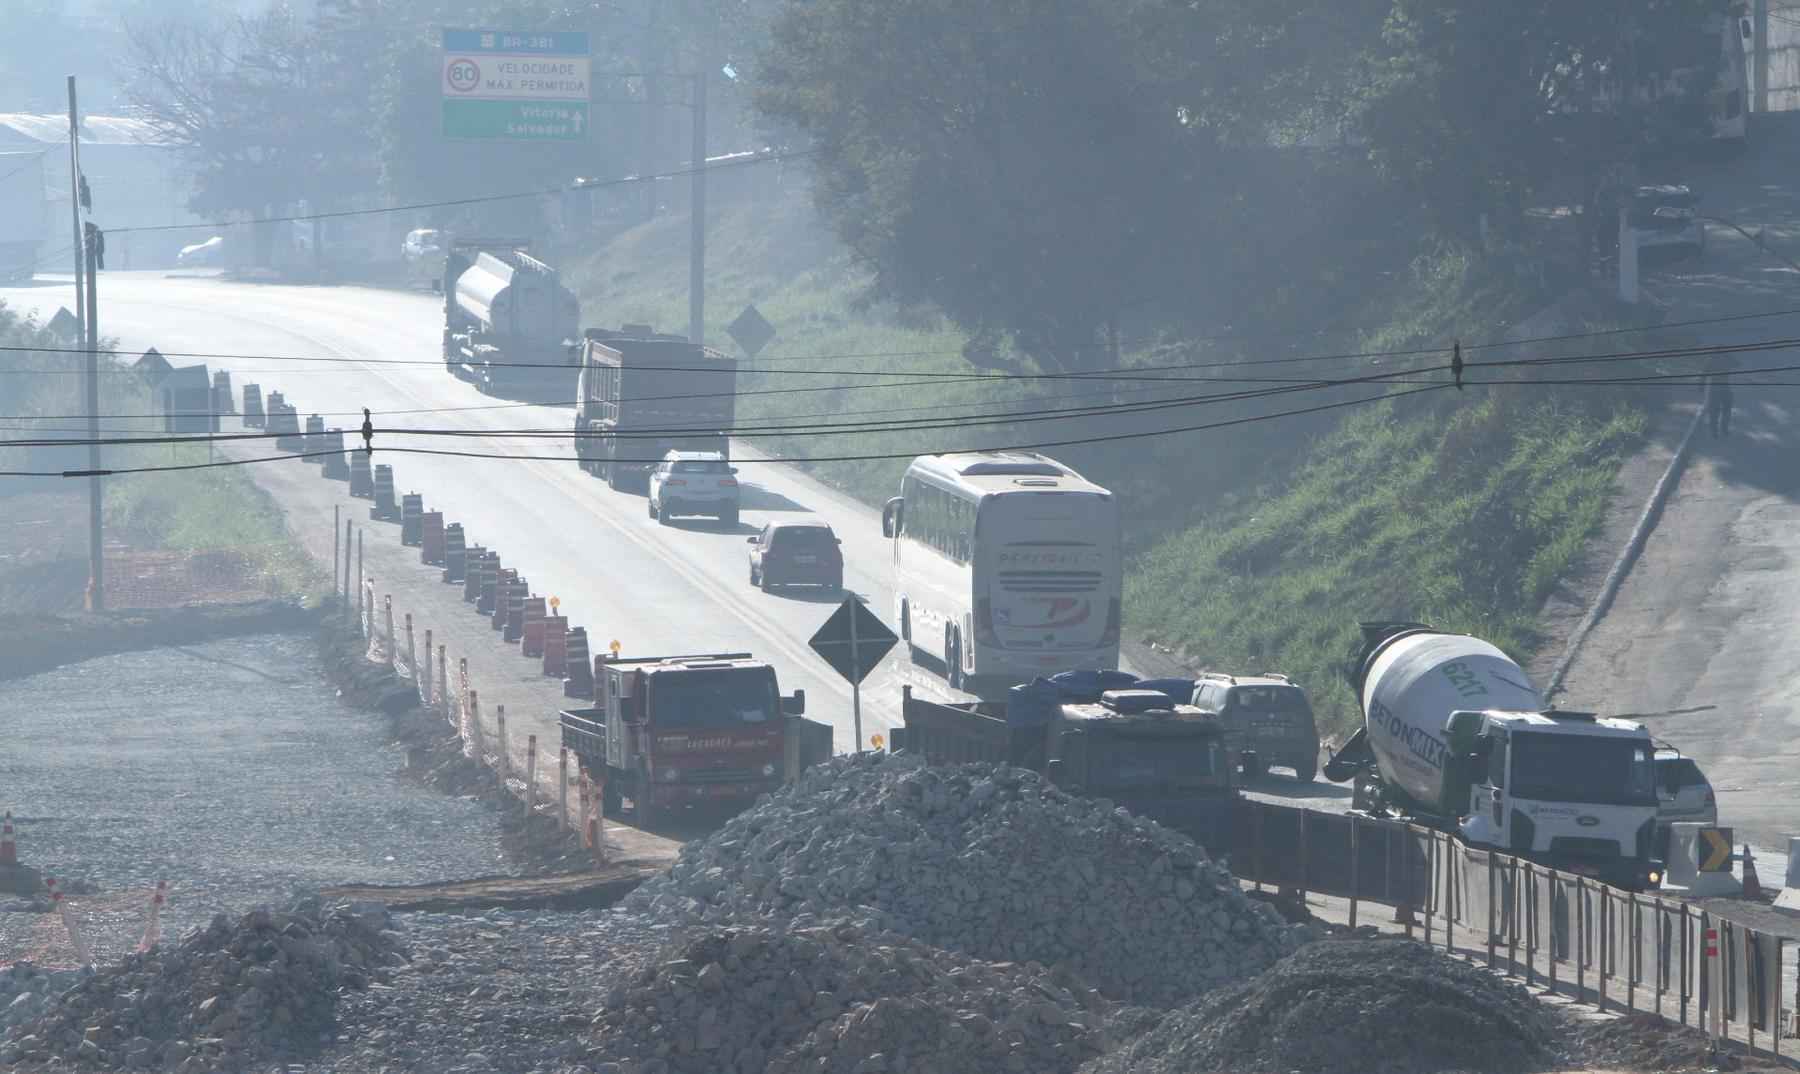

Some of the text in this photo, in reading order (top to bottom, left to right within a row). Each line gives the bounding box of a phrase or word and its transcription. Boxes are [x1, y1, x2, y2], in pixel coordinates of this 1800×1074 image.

[503, 36, 553, 49] BR-381
[452, 66, 475, 81] 80
[497, 63, 576, 75] VELOCIDADE
[520, 80, 585, 92] PERMITIDA
[1441, 662, 1488, 697] 6217
